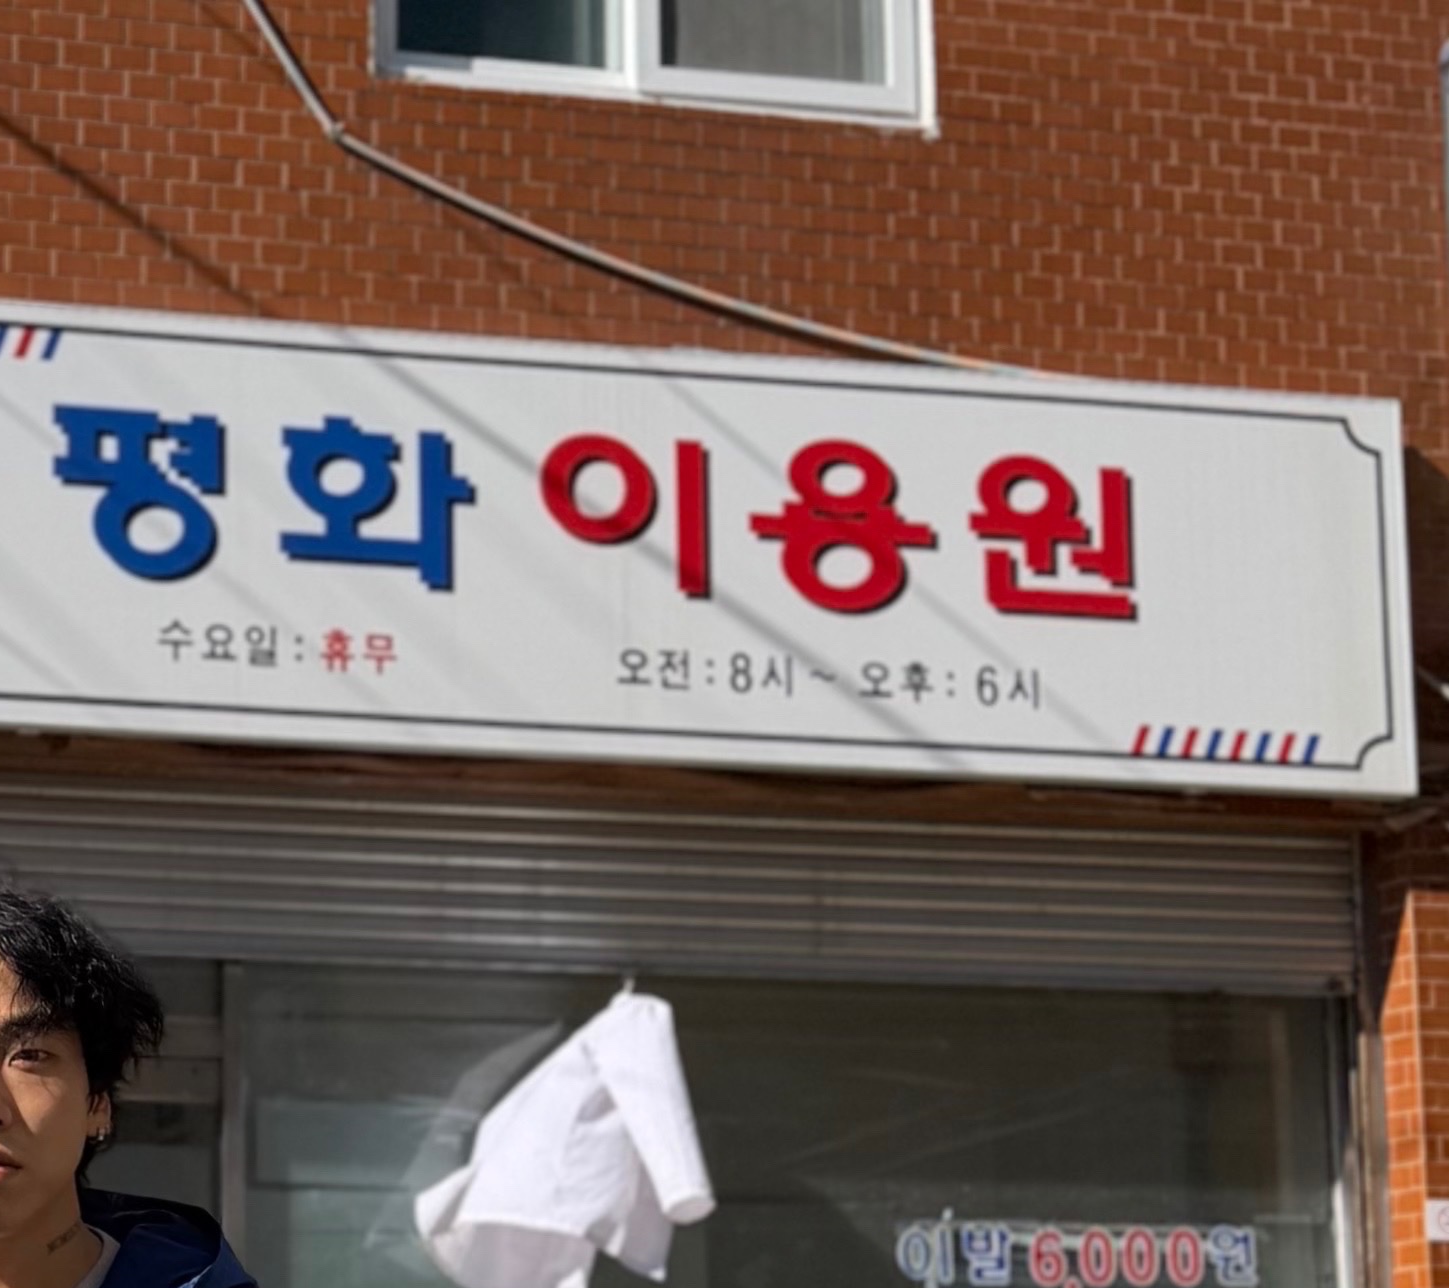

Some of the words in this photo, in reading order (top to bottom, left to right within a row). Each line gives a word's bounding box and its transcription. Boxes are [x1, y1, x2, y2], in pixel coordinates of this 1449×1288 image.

[52, 403, 476, 594] 평화
[540, 433, 1140, 622] 이용원
[897, 1225, 1011, 1286] 이발
